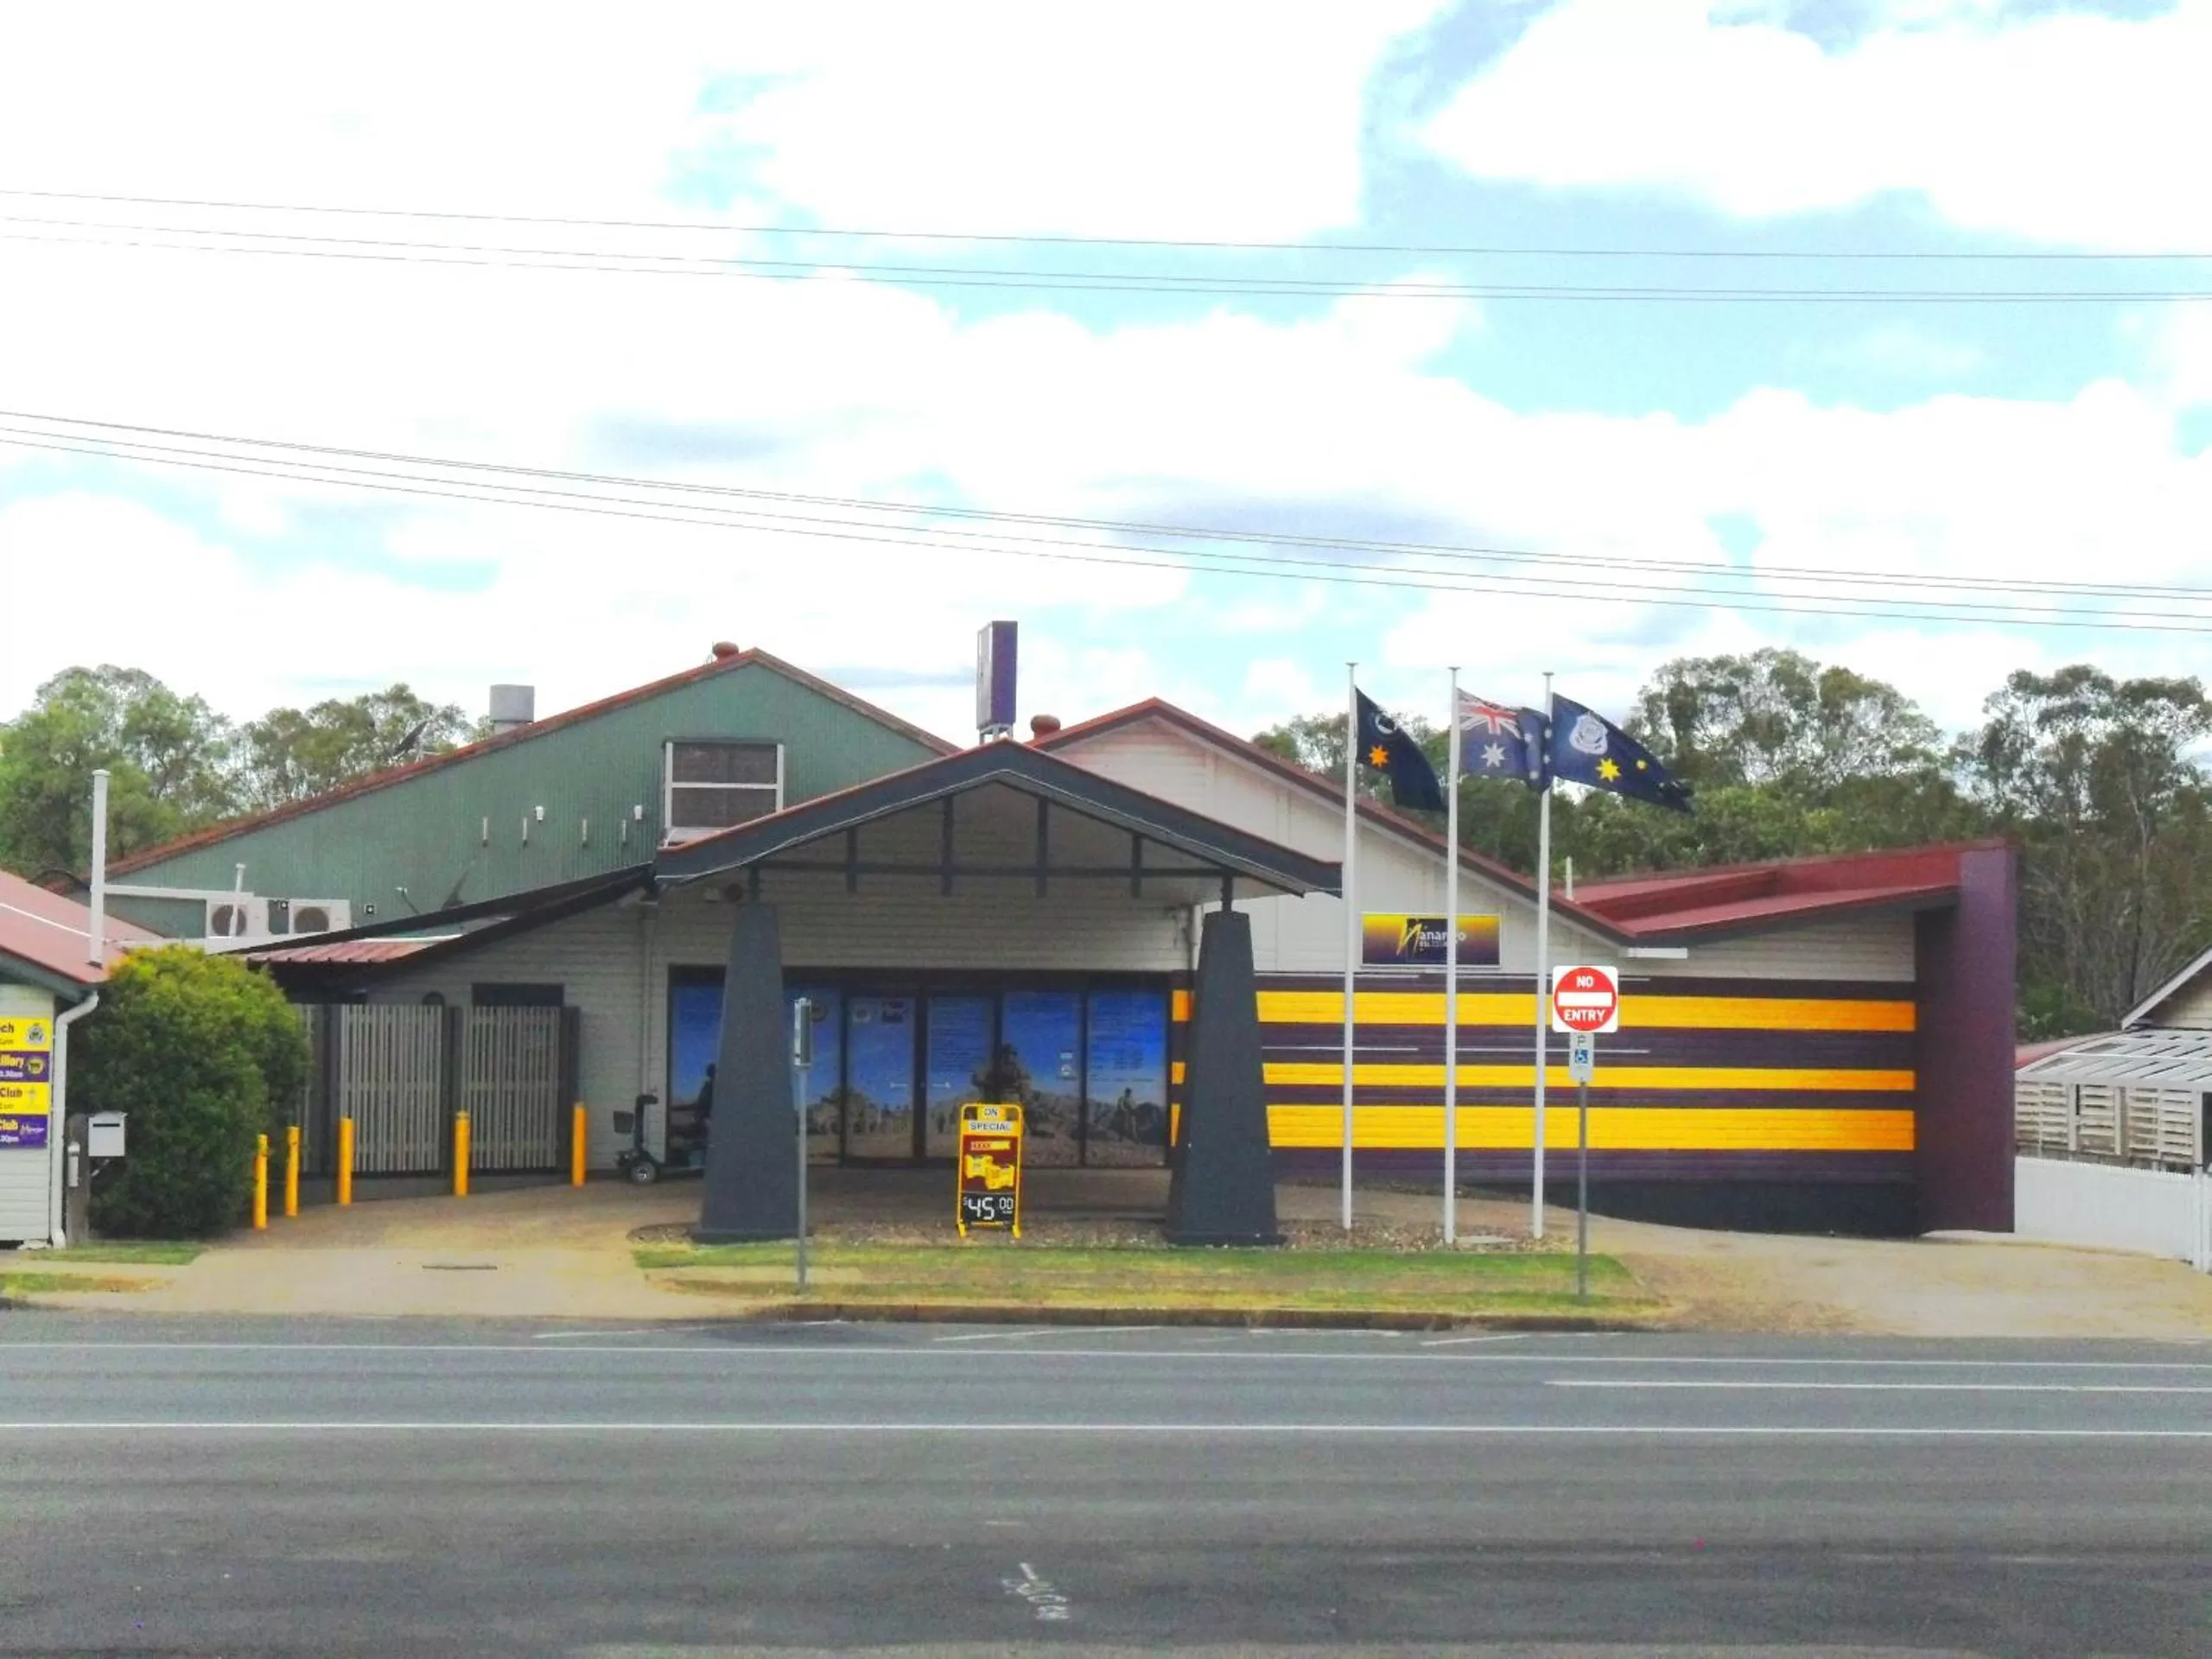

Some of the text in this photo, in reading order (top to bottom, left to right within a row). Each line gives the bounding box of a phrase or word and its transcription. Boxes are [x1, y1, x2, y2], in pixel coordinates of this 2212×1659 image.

[1575, 976, 1594, 988] NO
[1564, 1009, 1605, 1021] ENTRY
[984, 1108, 998, 1116] ON
